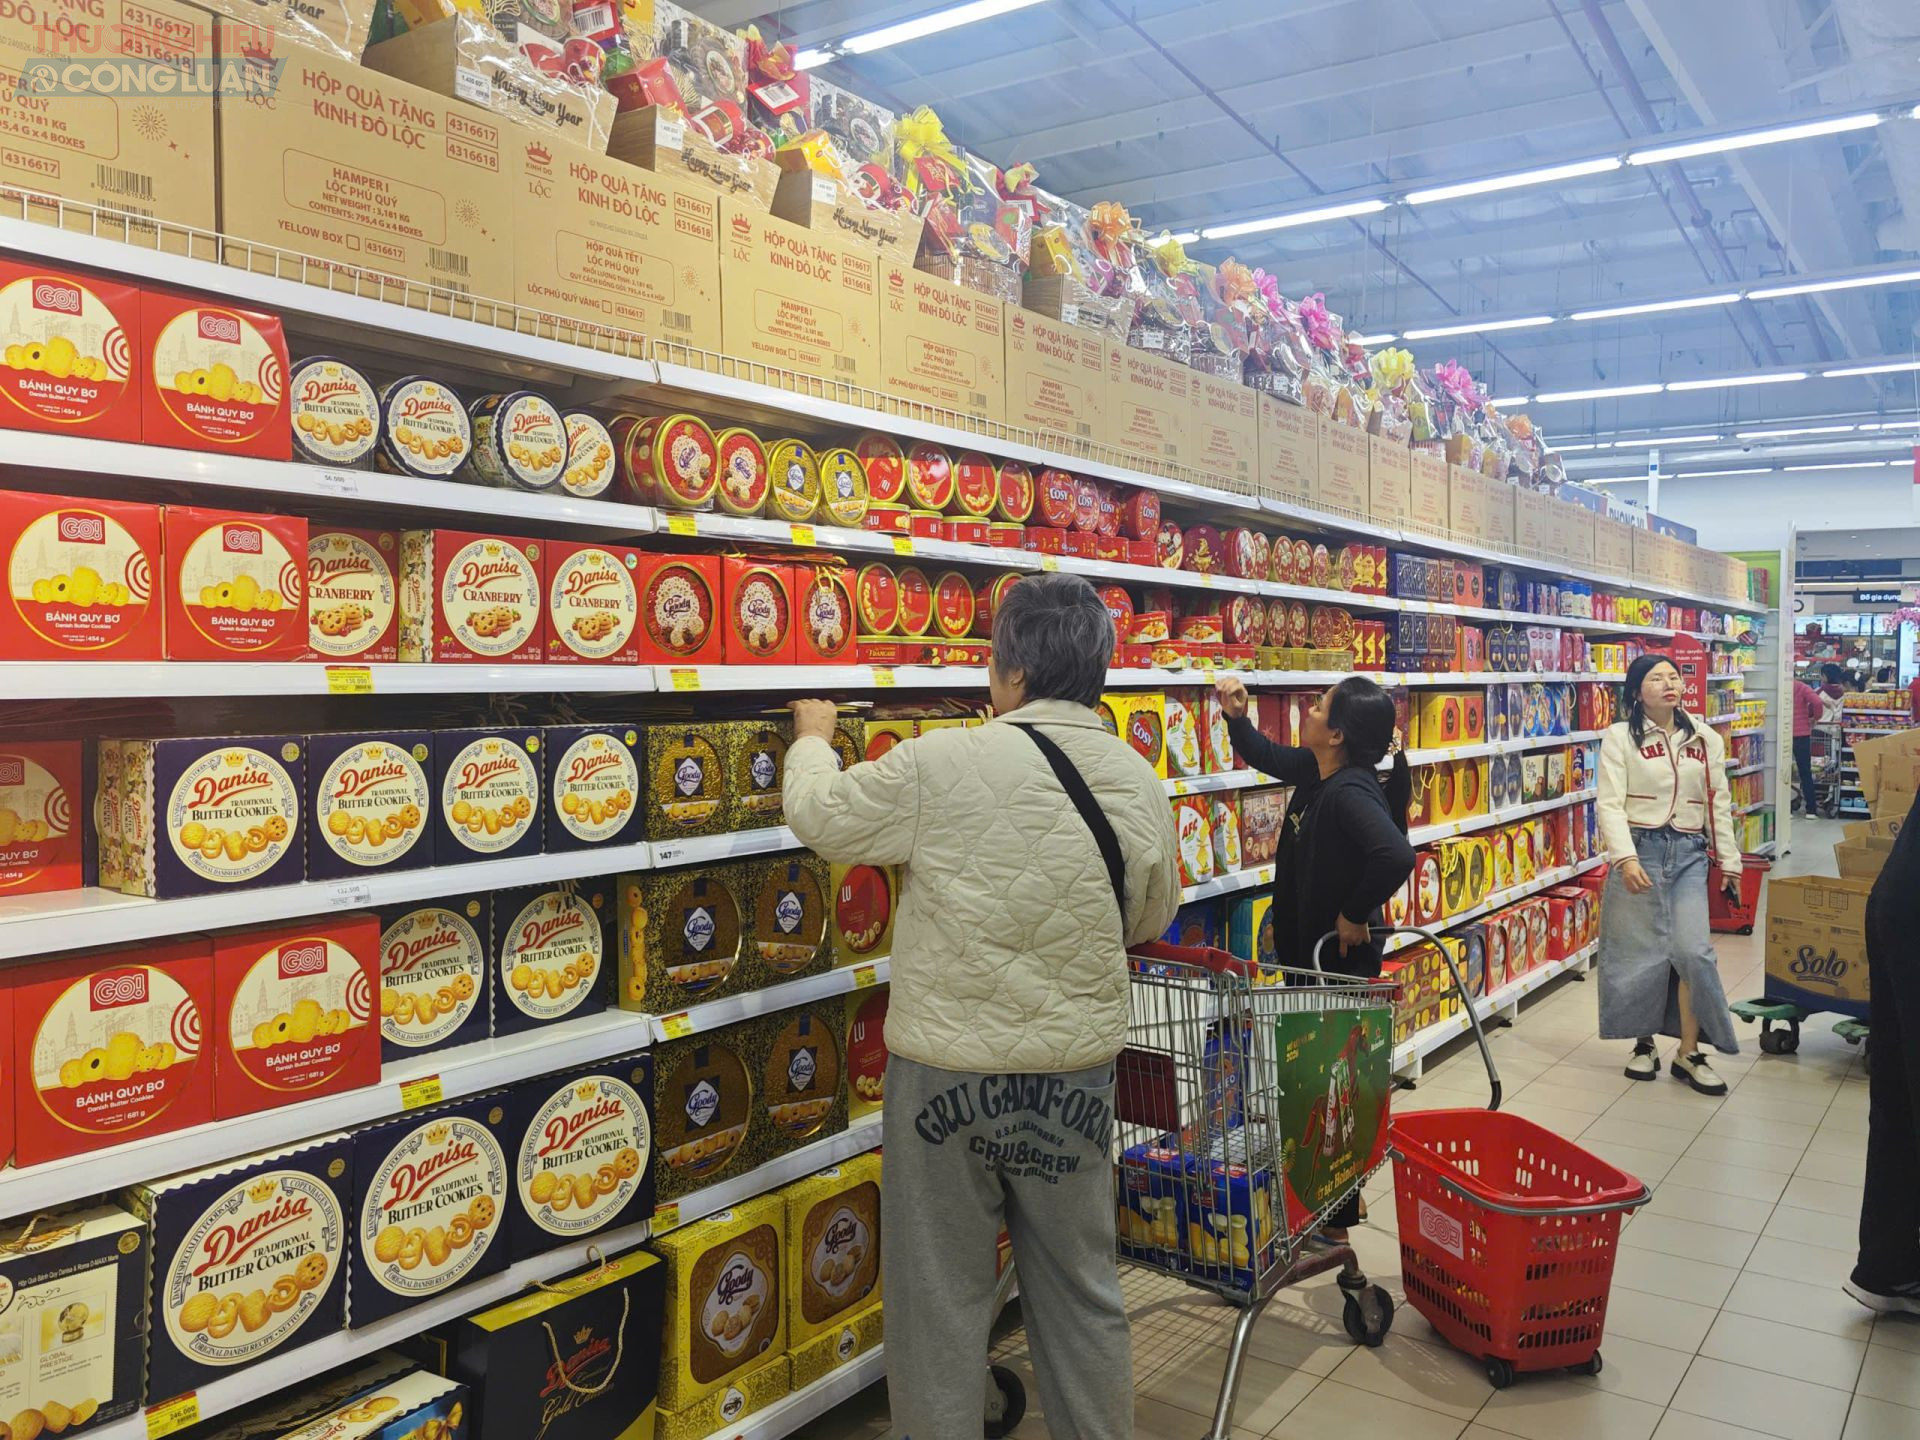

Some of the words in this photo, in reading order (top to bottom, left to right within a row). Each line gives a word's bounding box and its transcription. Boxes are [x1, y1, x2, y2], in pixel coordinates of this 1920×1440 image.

[43, 11, 90, 43] LỘC
[125, 8, 191, 38] 4316617
[124, 38, 192, 69] 4316618
[16, 94, 49, 113] QUÝ
[302, 68, 341, 97] HỘP
[346, 84, 384, 112] QUÀ
[388, 97, 436, 129] TẶNG
[313, 99, 356, 129] KINH
[361, 110, 388, 137] ĐÔ
[392, 123, 426, 150] LỘC
[448, 118, 496, 143] 4316617
[50, 132, 86, 150] BOXES
[5, 152, 57, 174] 4316617
[448, 143, 497, 168] 4316618
[333, 168, 383, 191] HAMPER
[528, 180, 552, 199] LỘC
[569, 162, 598, 185] HỘP
[601, 173, 630, 195] QUÀ
[632, 183, 667, 208] TẶNG
[325, 179, 347, 196] LỘC
[350, 185, 372, 199] PHÚ
[375, 194, 398, 208] QUÝ
[309, 200, 355, 220] CONTENTS:
[578, 187, 610, 211] KINH
[613, 198, 632, 217] ĐÔ
[635, 205, 660, 226] LỘC
[676, 196, 711, 217] 4316617
[278, 219, 320, 239] YELLOW
[322, 229, 343, 245] BOX
[676, 217, 712, 238] 4316618
[832, 208, 859, 232] Happy
[877, 225, 898, 247] Year
[586, 240, 604, 255] HỘP
[605, 245, 624, 261] QUÀ
[625, 250, 638, 264] TẾT
[764, 230, 786, 249] HỘP
[787, 239, 809, 257] QUÀ
[810, 246, 837, 268] TẶNG
[770, 251, 794, 270] KINH
[795, 260, 811, 276] ĐÔ
[813, 265, 832, 283] LỘC
[843, 256, 870, 273] 4316617
[527, 282, 543, 295] LỘC
[544, 285, 561, 299] PHÚ
[561, 290, 578, 303] QUÝ
[578, 295, 600, 310] VÀNG
[844, 275, 871, 292] 4316618
[35, 284, 80, 312] GO!
[913, 282, 931, 297] HỘP
[931, 289, 949, 304] QUÀ
[950, 294, 971, 312] TẶNG
[918, 301, 938, 317] KINH
[938, 307, 951, 321] ĐÔ
[952, 310, 968, 328] LỘC
[200, 314, 239, 342] GO!
[19, 377, 52, 392] BÁNH
[54, 384, 78, 399] QUY
[80, 386, 98, 400] BƠ
[301, 378, 360, 403] Danisa
[187, 402, 215, 414] BÁNH
[217, 406, 238, 419] QUY
[239, 410, 254, 421] BƠ
[401, 395, 453, 420] Danisa
[511, 409, 553, 433] Danisa
[1050, 488, 1069, 501] COSY
[60, 516, 103, 541] GO!
[225, 529, 260, 551] GO!
[308, 552, 374, 586] Danisa
[457, 553, 522, 589] Danisa
[564, 565, 621, 596] Danisa
[308, 585, 375, 602] CRANBERRY
[463, 588, 523, 604] CRANBERRY
[568, 595, 623, 610] CRANBERRY
[45, 611, 78, 623] BÁNH
[80, 613, 103, 624] QUY
[104, 613, 121, 624] BƠ
[211, 616, 238, 627] BÁNH
[240, 617, 259, 629] QUY
[261, 617, 275, 628] BƠ
[1167, 709, 1183, 729] AFC
[1133, 721, 1154, 747] COSY
[335, 759, 407, 799] Danisa
[457, 753, 520, 790] Danisa
[567, 750, 622, 783] Danisa
[188, 766, 273, 809] Danisa
[460, 788, 490, 800] BUTTER
[491, 786, 524, 798] COOKIES
[192, 808, 232, 821] BUTTER
[234, 806, 278, 819] COOKIES
[231, 798, 273, 806] TRADITIONAL
[338, 797, 372, 810] BUTTER
[373, 795, 412, 807] COOKIES
[659, 851, 673, 861] 147
[842, 886, 852, 903] LU
[518, 908, 583, 953] Danisa
[281, 947, 324, 976] GO!
[382, 927, 461, 976] Danisa
[520, 951, 553, 965] BUTTER
[553, 944, 588, 959] COOKIES
[1788, 945, 1848, 979] Solo
[386, 973, 423, 988] BUTTER
[424, 964, 464, 980] COOKIES
[93, 973, 146, 1006] GO!
[266, 1053, 297, 1068] BÁNH
[299, 1046, 323, 1064] QUY
[324, 1042, 341, 1056] BƠ
[76, 1089, 113, 1108] BÁNH
[115, 1083, 145, 1102] QUY
[146, 1078, 165, 1094] BƠ
[87, 1103, 109, 1113] Danish
[110, 1099, 129, 1109] Butter
[130, 1094, 154, 1106] Cookies
[127, 1111, 138, 1120] 681
[538, 1097, 625, 1158] Danisa
[581, 1129, 624, 1147] TRADITIONAL
[542, 1152, 583, 1171] BUTTER
[584, 1137, 629, 1157] COOKIES
[383, 1139, 479, 1211] Danisa
[431, 1173, 478, 1196] TRADITIONAL
[388, 1200, 433, 1225] BUTTER
[435, 1183, 483, 1208] COOKIES
[192, 1195, 313, 1277] Danisa
[253, 1231, 311, 1258] TRADITIONAL
[198, 1262, 254, 1292] BUTTER
[257, 1240, 316, 1270] COOKIES
[718, 1264, 754, 1306] Goody
[169, 1405, 196, 1421] 246.000
